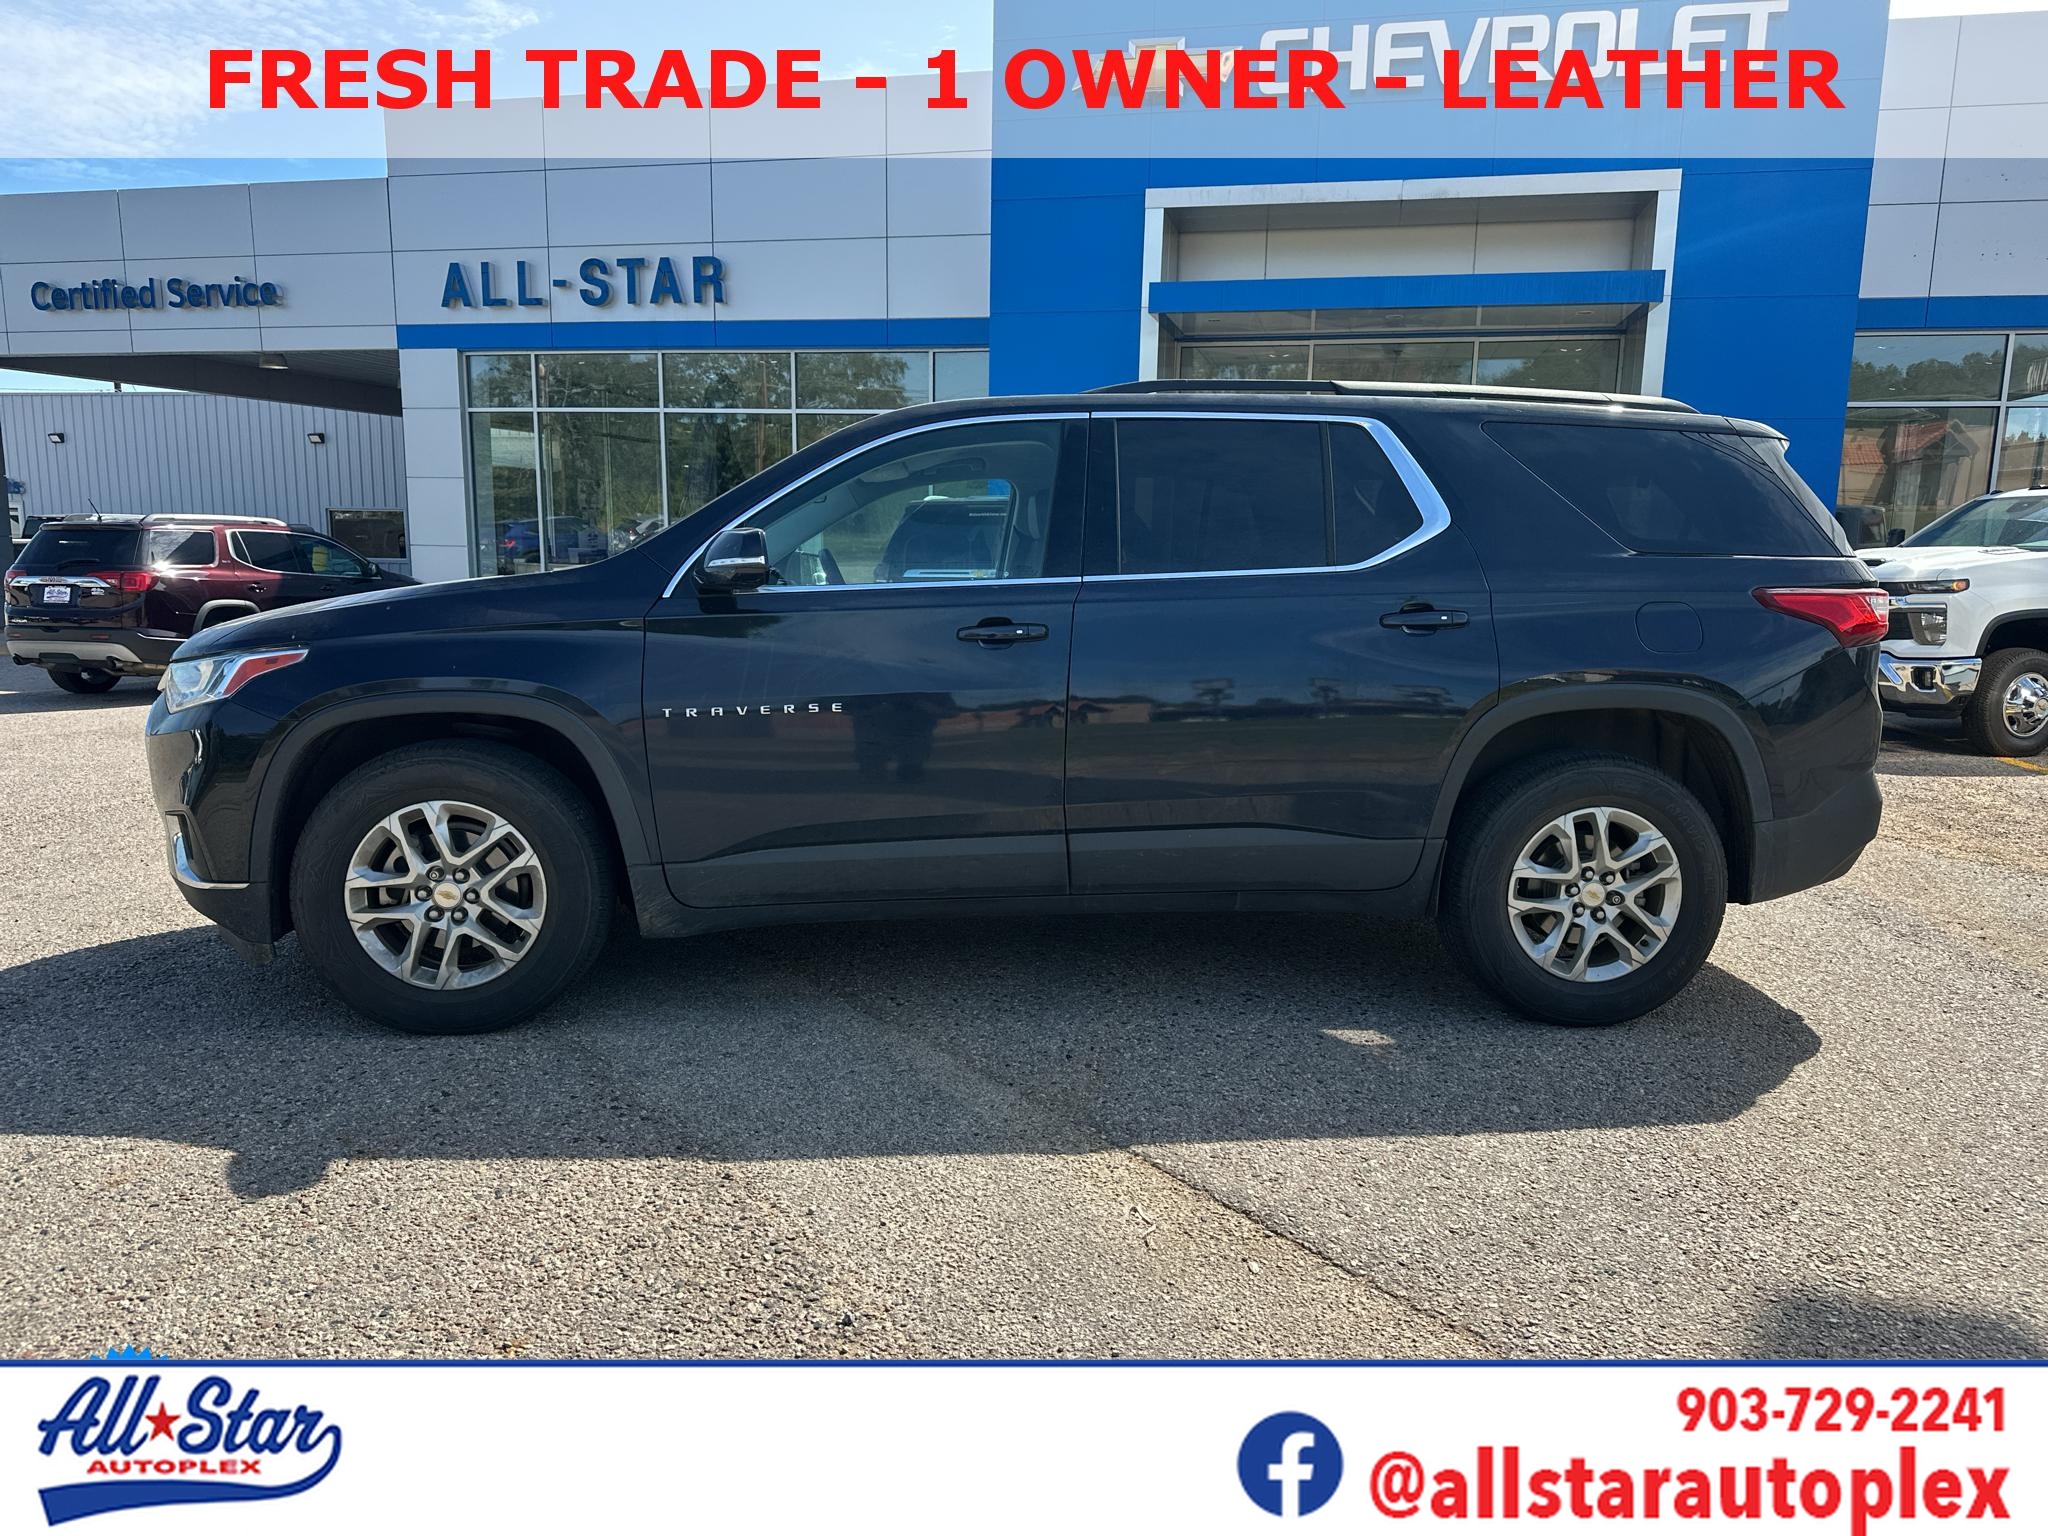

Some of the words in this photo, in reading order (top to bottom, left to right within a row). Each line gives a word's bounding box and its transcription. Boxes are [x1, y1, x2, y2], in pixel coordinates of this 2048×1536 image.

[1257, 0, 1790, 95] CHEVROLET
[30, 276, 157, 311] Certified
[167, 275, 279, 309] Service
[441, 254, 725, 308] ALL-STAR
[662, 702, 844, 718] TRAVERSE
